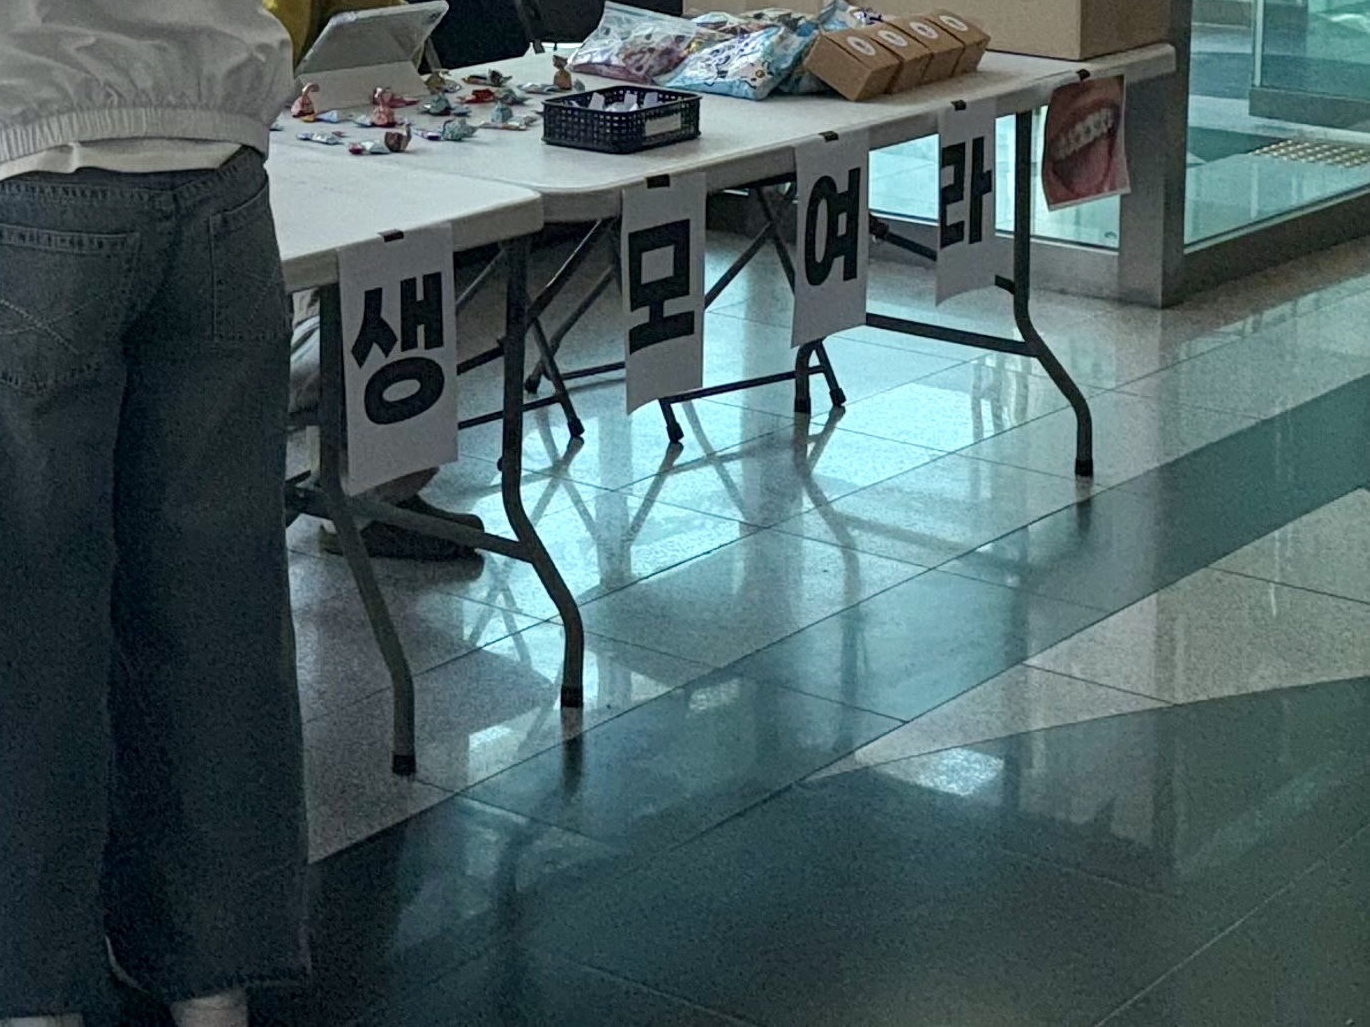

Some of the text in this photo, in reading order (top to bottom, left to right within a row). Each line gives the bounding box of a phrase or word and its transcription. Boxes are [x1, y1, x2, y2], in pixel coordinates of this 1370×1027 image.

[351, 271, 445, 425] 생
[628, 219, 695, 356] 모
[804, 167, 861, 286] 여
[940, 136, 992, 249] 라
